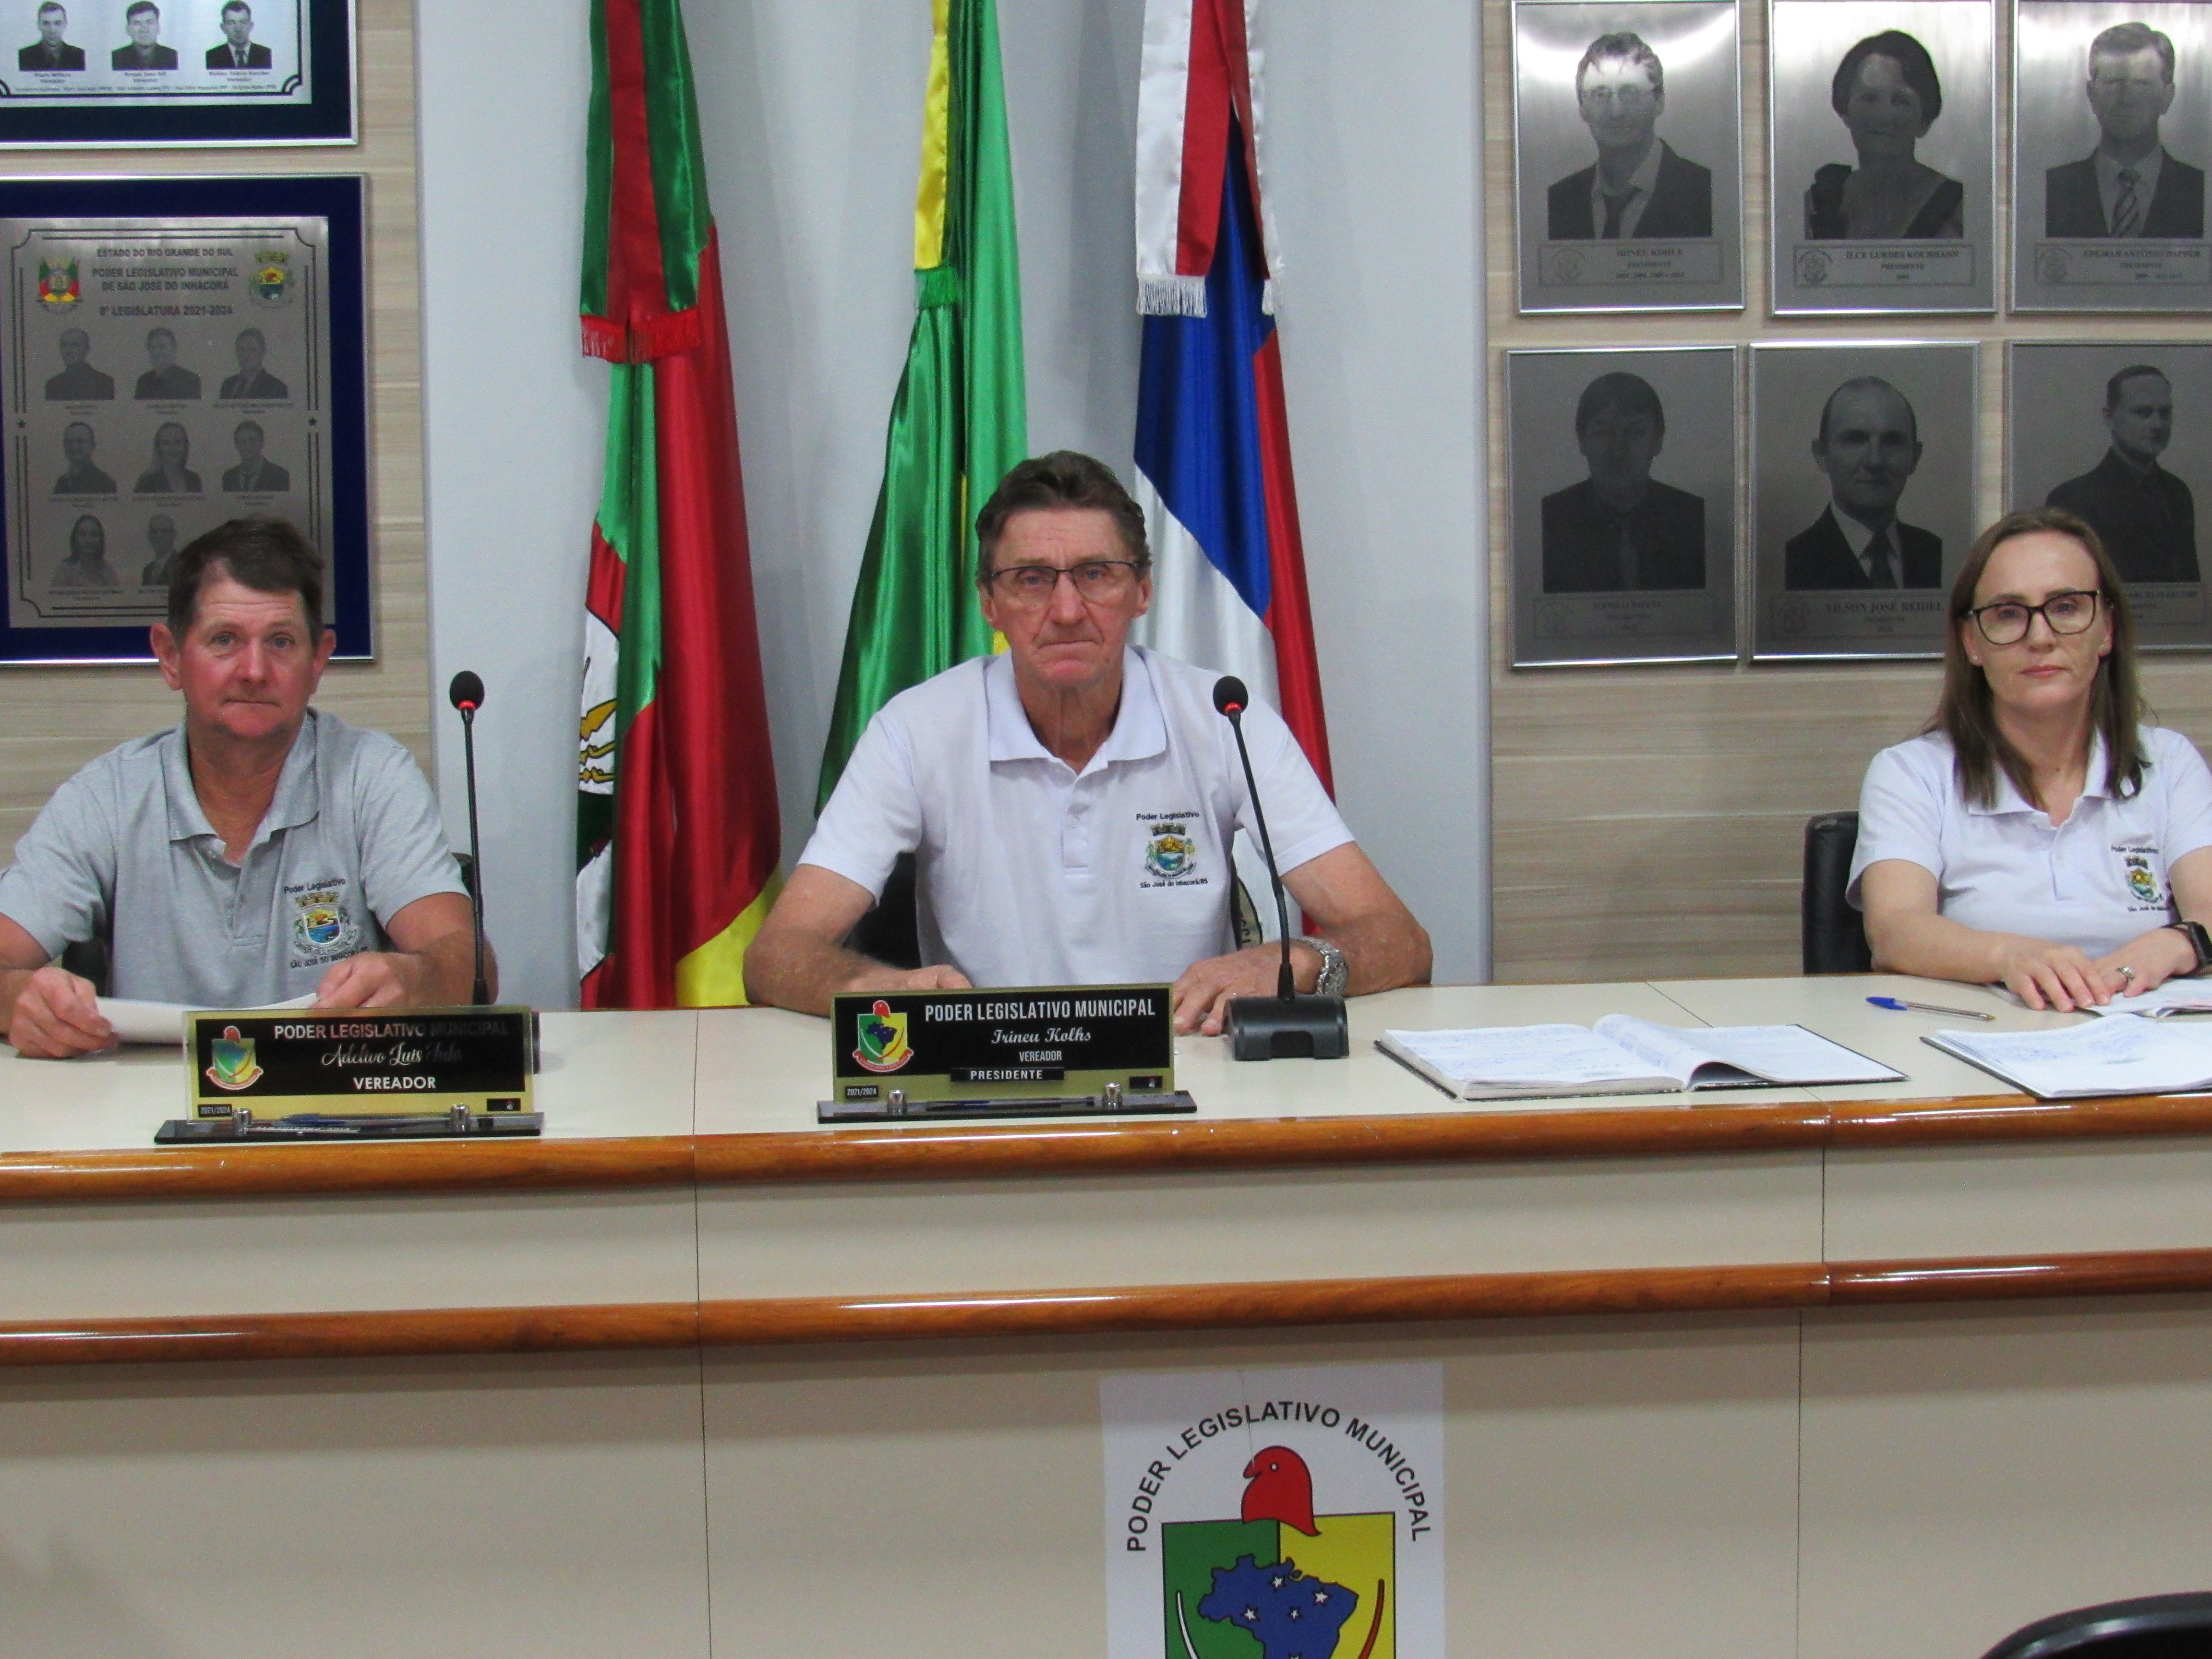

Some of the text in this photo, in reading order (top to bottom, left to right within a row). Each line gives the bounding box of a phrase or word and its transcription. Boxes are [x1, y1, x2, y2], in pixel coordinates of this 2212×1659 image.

[97, 247, 233, 257] ESTADO DO RIO GRANDE DO SUL
[92, 267, 239, 278] PODER LEGISLATIVO MUNICIPAL
[102, 281, 114, 291] DE
[165, 281, 178, 290] DO
[112, 305, 180, 316] LEGISLATURA
[183, 305, 233, 315] 2021-2024
[1136, 811, 1200, 821] Poder Legislativo
[284, 885, 305, 894] Poder
[925, 999, 1155, 1022] PODER LEGISLATIVO MUNICIPAL
[274, 1022, 510, 1039] PODER LEGISLATIVO MUNICIPAL
[991, 1027, 1092, 1044] Irineu Kolhs
[389, 1042, 422, 1066] Luis
[1019, 1050, 1063, 1062] VEREADOR
[970, 1070, 1043, 1080] PRESIDENTE
[352, 1076, 436, 1090] VEREADOR
[846, 1087, 877, 1096] 2021/2024
[200, 1106, 231, 1115] 2021/2024
[1126, 1401, 1431, 1552] PODER LEGISLATIVO MUNICIPAL
